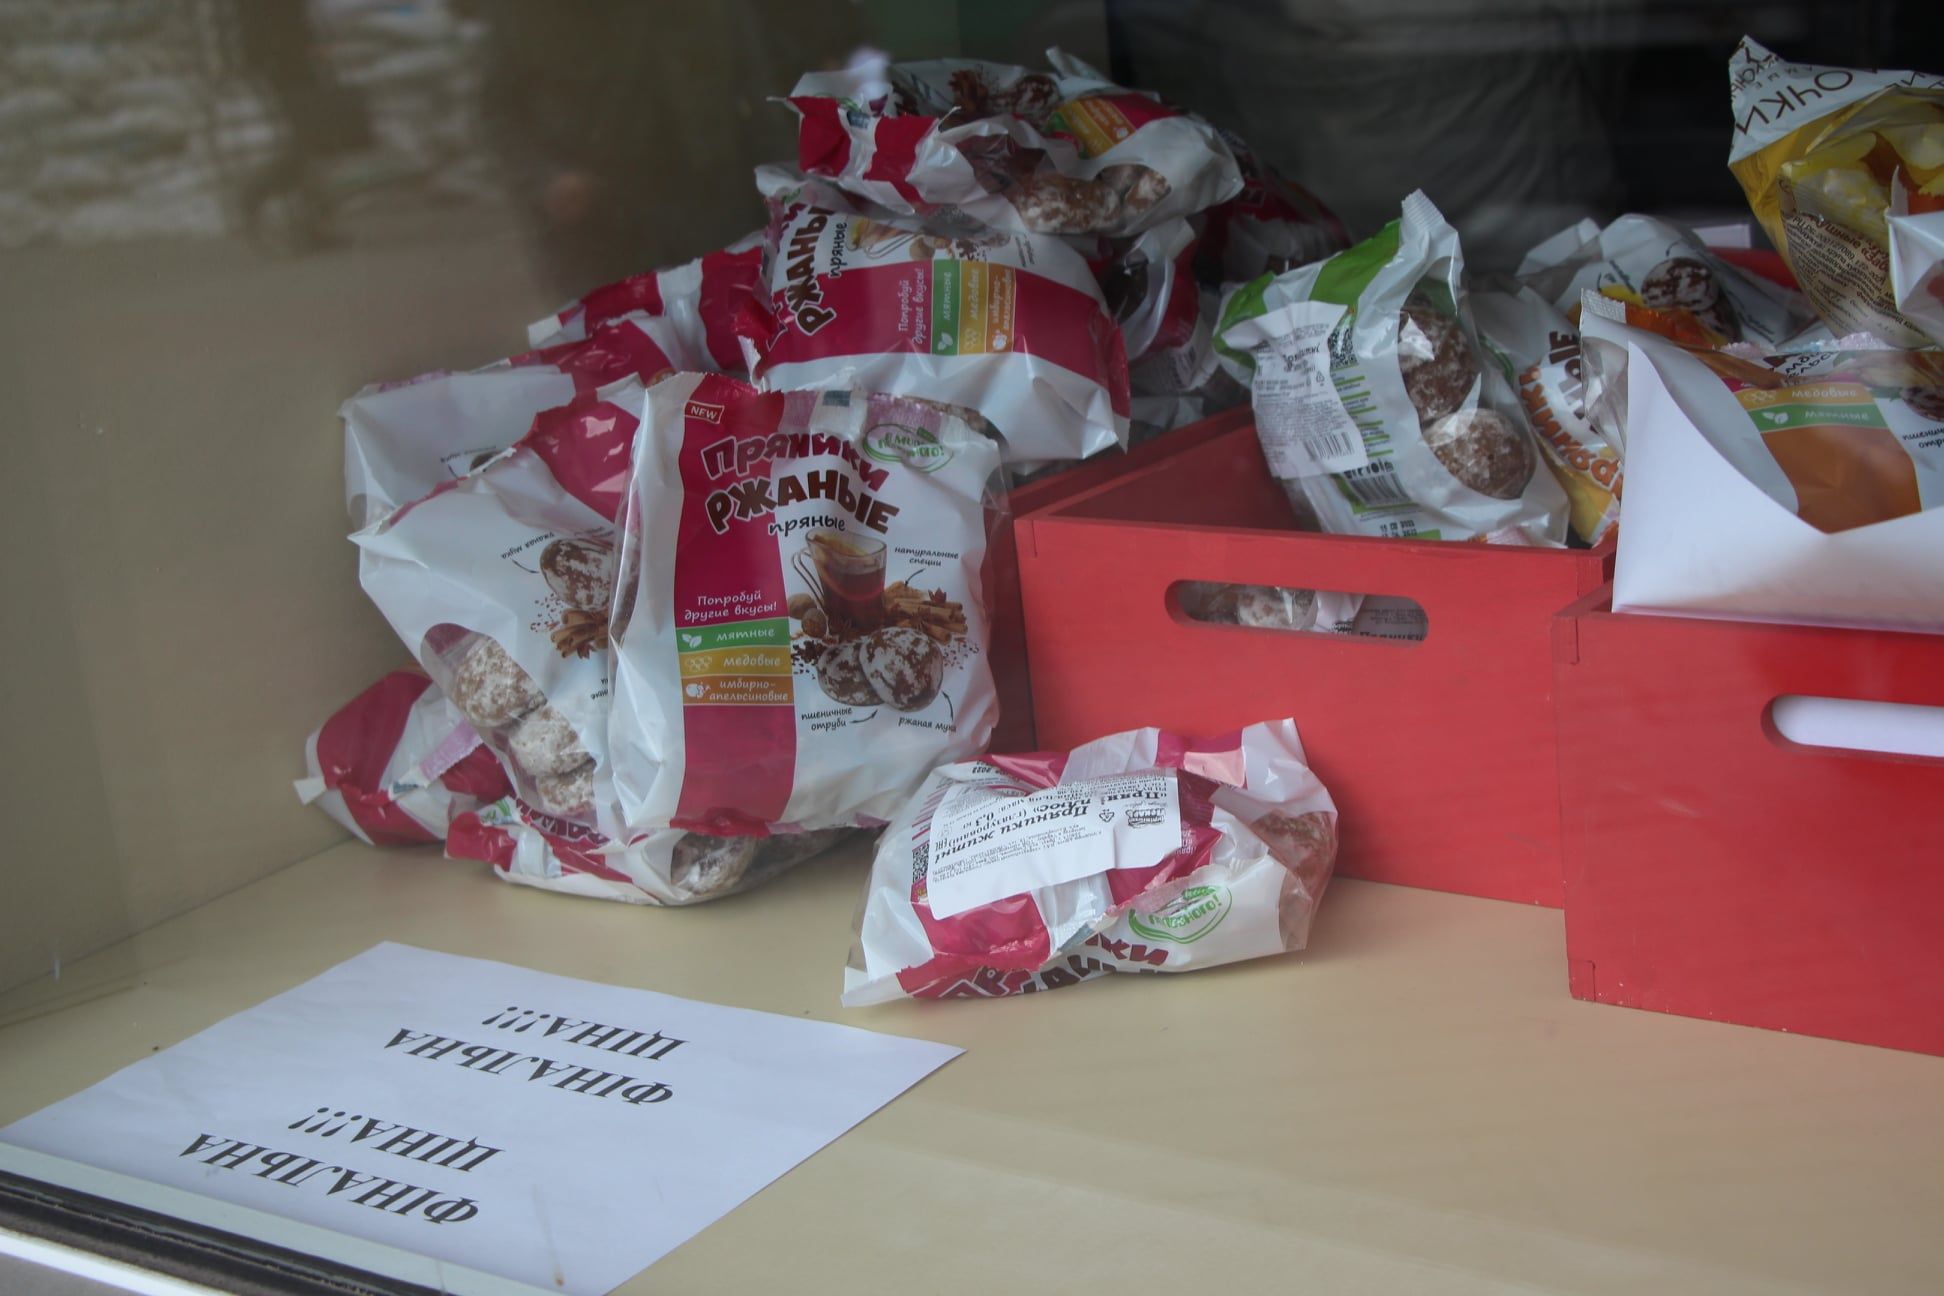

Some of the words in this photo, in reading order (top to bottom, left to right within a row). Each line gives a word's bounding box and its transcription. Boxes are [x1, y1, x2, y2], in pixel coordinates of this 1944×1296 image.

[690, 405, 718, 421] NEW
[706, 468, 900, 534] РЖАНЫЕ
[769, 515, 846, 536] пряные
[894, 546, 959, 560] натуральные
[697, 590, 763, 608] Попробуй
[684, 608, 729, 624] другие
[734, 601, 778, 620] вкусы!
[716, 627, 776, 643] мятные
[722, 654, 781, 669] медовые
[719, 678, 776, 695] имбирно-
[709, 690, 789, 703] апельсиновые
[801, 706, 853, 722] пшеничные
[898, 716, 933, 730] ржаная
[811, 717, 847, 732] отруби
[1000, 805, 1090, 835] Пряники
[934, 830, 996, 865] житні
[481, 1006, 691, 1061] ЦІНА!!!
[384, 1027, 674, 1105] ФІНАЛЬНА
[288, 1106, 507, 1172] ЦІНА!!!
[178, 1132, 480, 1224] ФІНАЛЬНА
